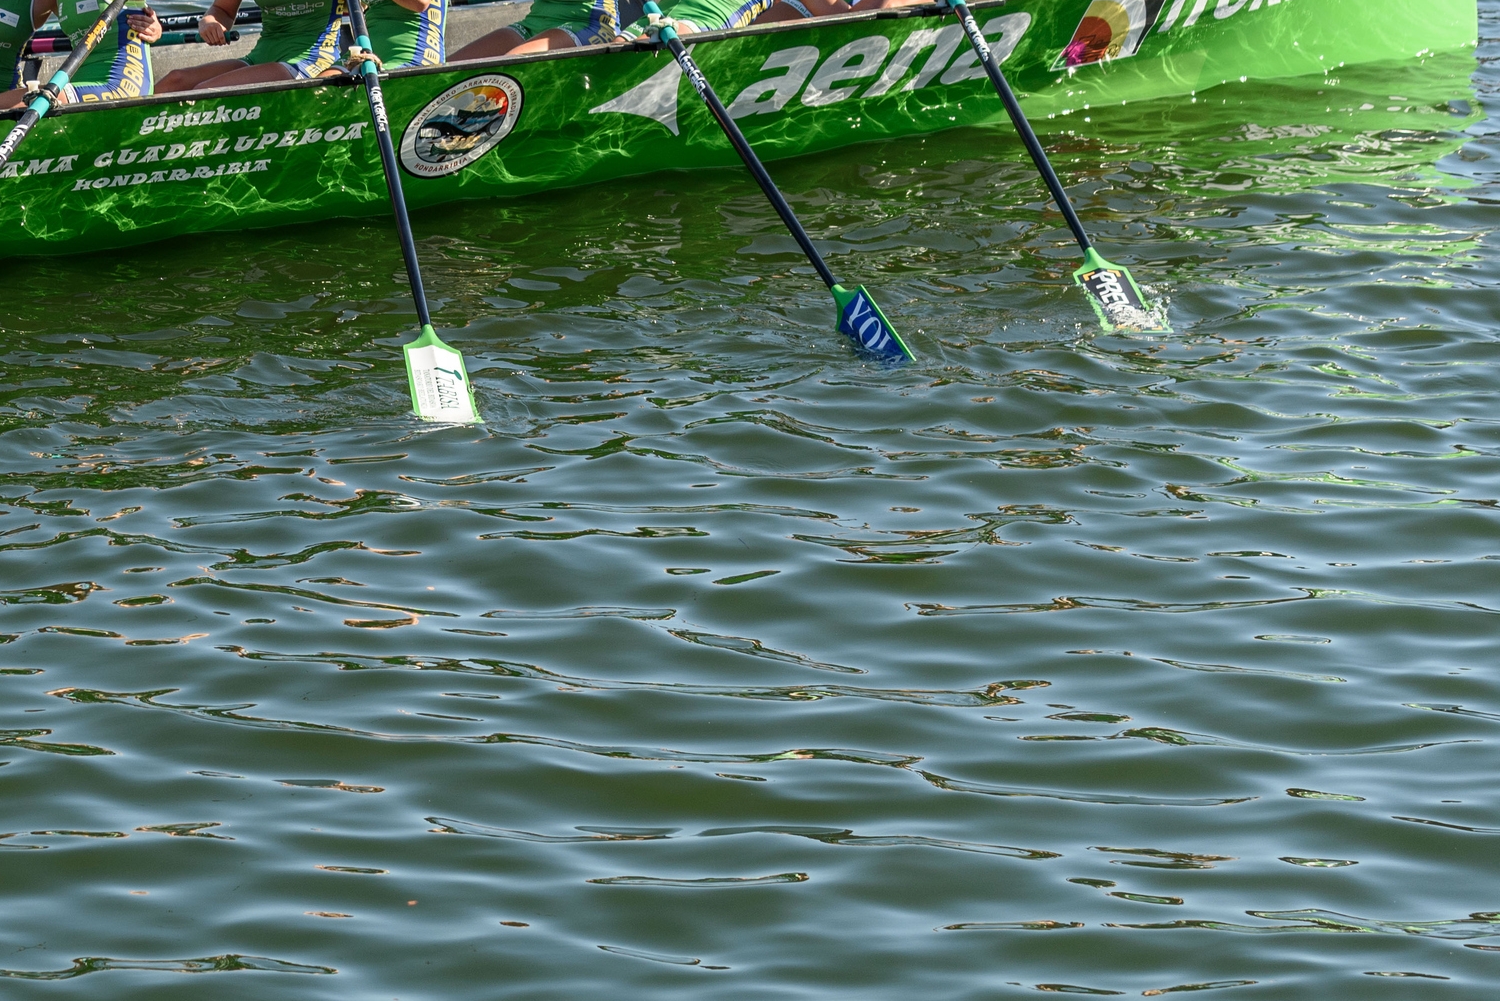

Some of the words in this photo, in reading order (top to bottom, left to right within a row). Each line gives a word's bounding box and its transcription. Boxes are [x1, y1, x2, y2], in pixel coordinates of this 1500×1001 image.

[426, 23, 442, 49] BM
[123, 55, 144, 85] BM
[726, 11, 1032, 120] aena
[138, 104, 263, 135] gipuzkoa
[93, 120, 369, 167] GUADALUPEKOA
[71, 158, 272, 192] HONDARRIBIA
